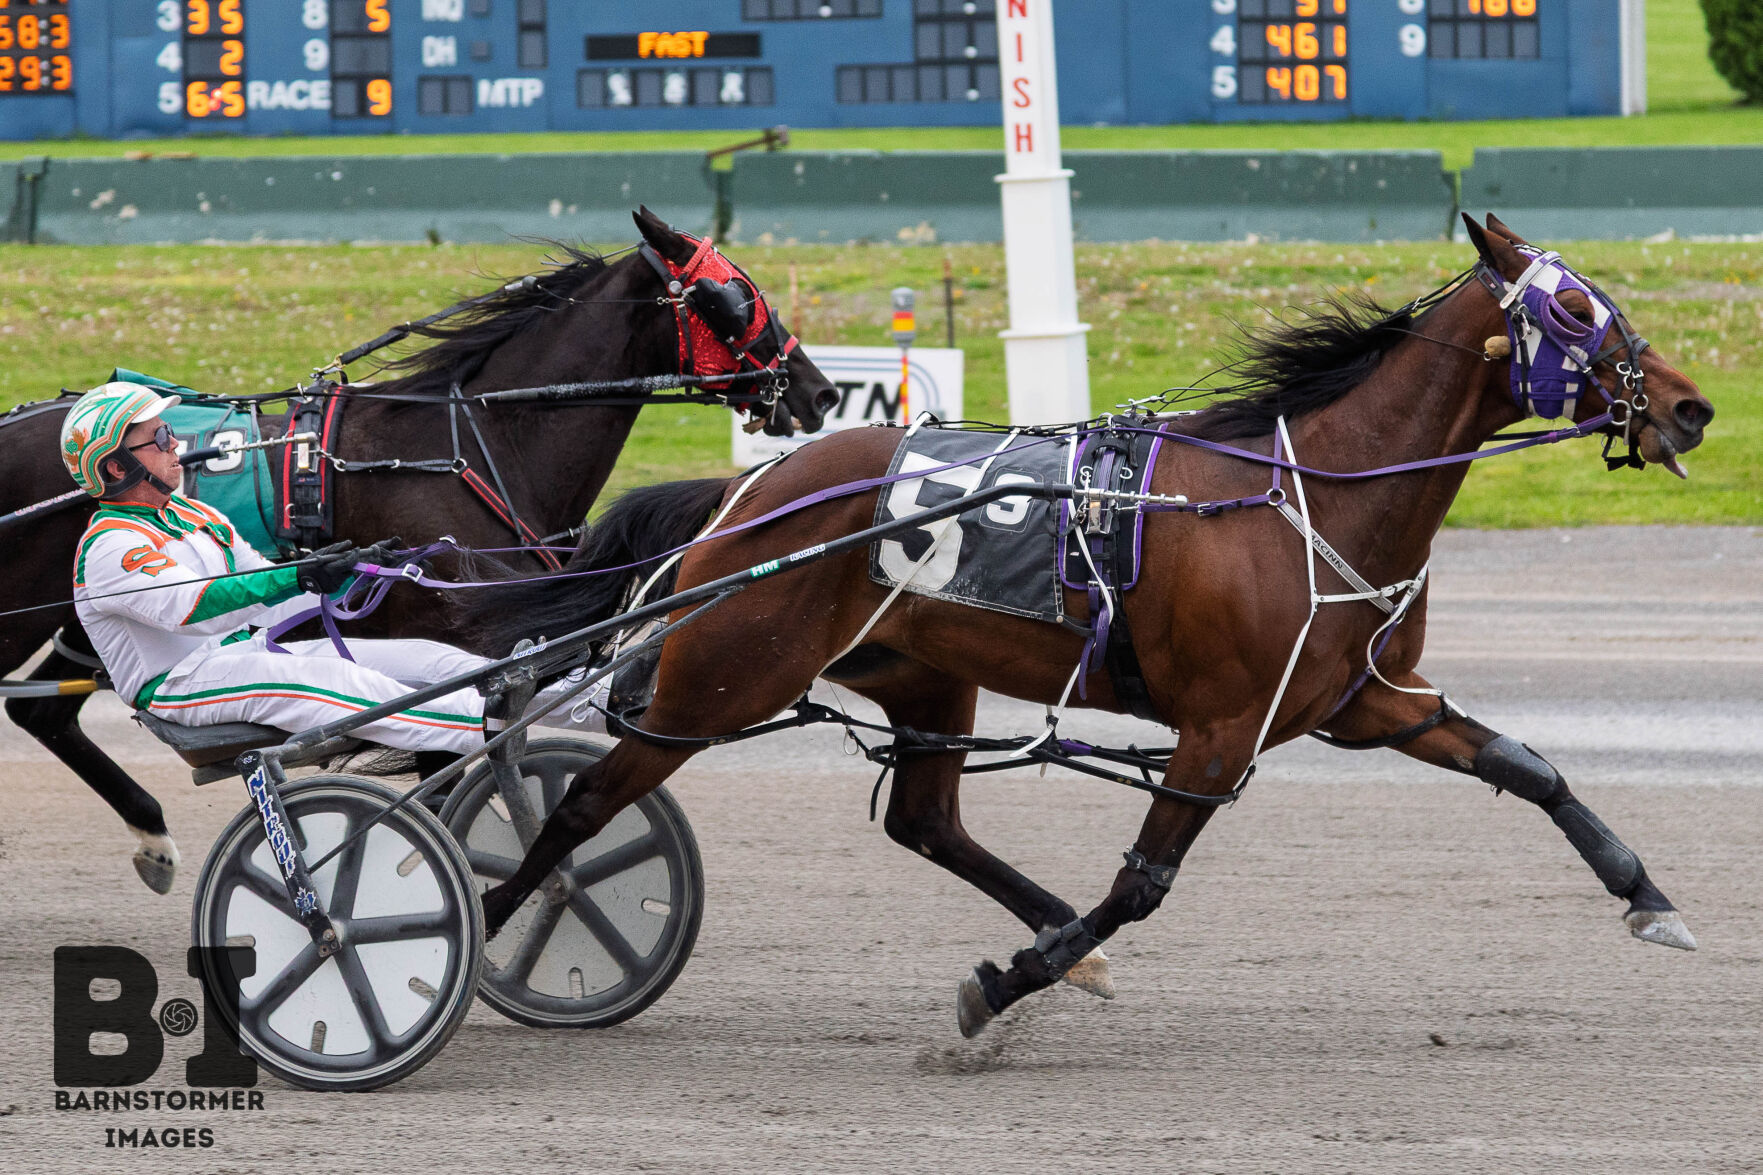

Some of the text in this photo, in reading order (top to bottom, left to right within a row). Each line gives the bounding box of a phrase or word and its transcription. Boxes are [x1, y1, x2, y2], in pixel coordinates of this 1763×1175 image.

[157, 0, 181, 31] 3
[303, 38, 328, 71] 9
[422, 36, 456, 67] DH
[638, 31, 709, 58] FAST
[1211, 23, 1346, 59] 4 461
[1400, 24, 1426, 57] 9
[157, 40, 243, 75] 4 2
[158, 81, 182, 114] 5
[247, 79, 392, 115] RACE 9
[478, 78, 543, 107] MTP
[1212, 65, 1346, 100] 5 407
[205, 430, 244, 472] 3
[879, 451, 981, 592] 5
[752, 560, 778, 576] HM
